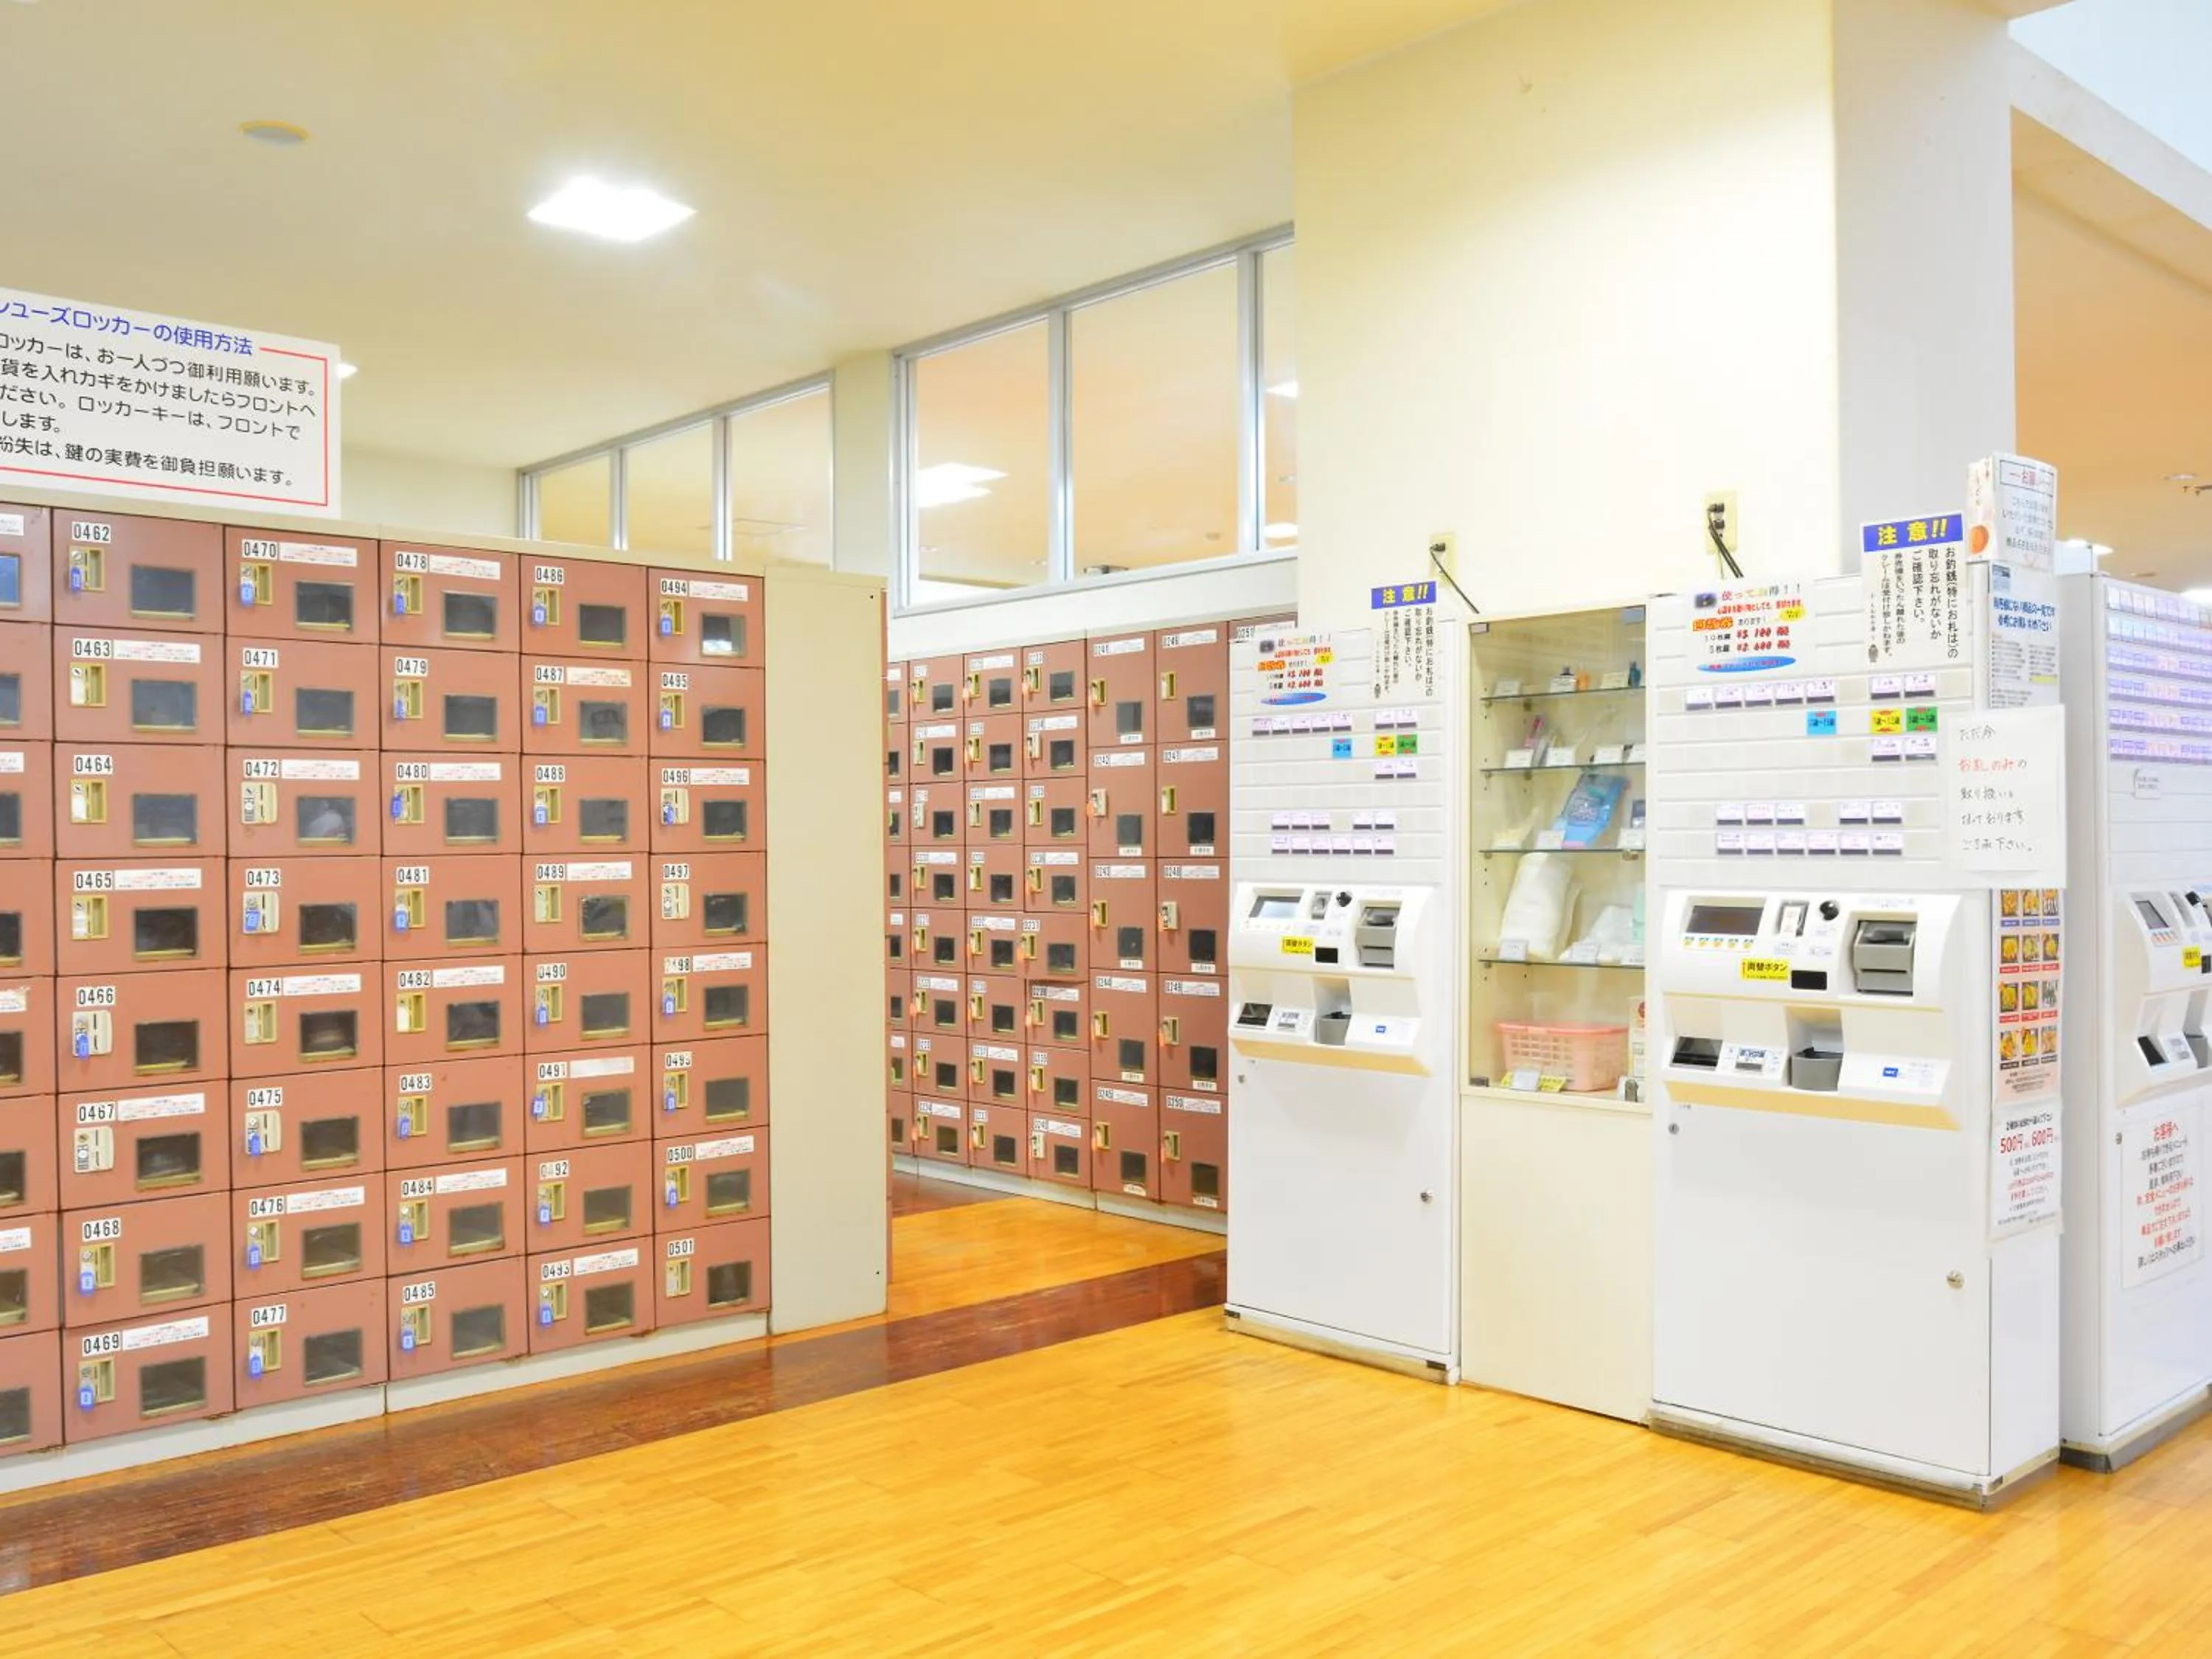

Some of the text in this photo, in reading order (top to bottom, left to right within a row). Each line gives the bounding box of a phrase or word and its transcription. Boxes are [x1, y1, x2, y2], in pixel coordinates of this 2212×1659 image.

[2, 411, 60, 433] します。
[74, 525, 110, 541] 0462
[244, 543, 277, 558] 0470
[397, 554, 428, 568] 0478
[535, 568, 563, 582] 0486
[661, 581, 687, 594] 0494
[74, 641, 111, 656] 0463
[245, 650, 276, 666] 0471
[397, 659, 427, 674] 0479
[536, 668, 563, 681] 0487
[661, 674, 688, 687] 0495
[76, 757, 111, 773] 0464
[246, 762, 277, 776] 0472
[397, 765, 428, 779] 0480
[536, 768, 564, 782] 0488
[663, 771, 689, 783] 0496
[248, 870, 279, 886] 0473
[398, 869, 428, 882] 0481
[538, 866, 565, 878] 0489
[76, 873, 111, 889] 0465
[400, 973, 430, 987] 0482
[78, 988, 114, 1004] 0466
[248, 981, 280, 996] 0474
[401, 1075, 431, 1091] 0483
[248, 1089, 282, 1105] 0475
[79, 1105, 114, 1121] 0467
[668, 1147, 692, 1161] 0500
[403, 1182, 433, 1195] 0484
[251, 1199, 284, 1215] 0476
[84, 1220, 119, 1238] 0468
[669, 1240, 692, 1255] 0501
[404, 1284, 435, 1301] 0485
[252, 1306, 285, 1324] 0477
[83, 1334, 119, 1353] 0469
